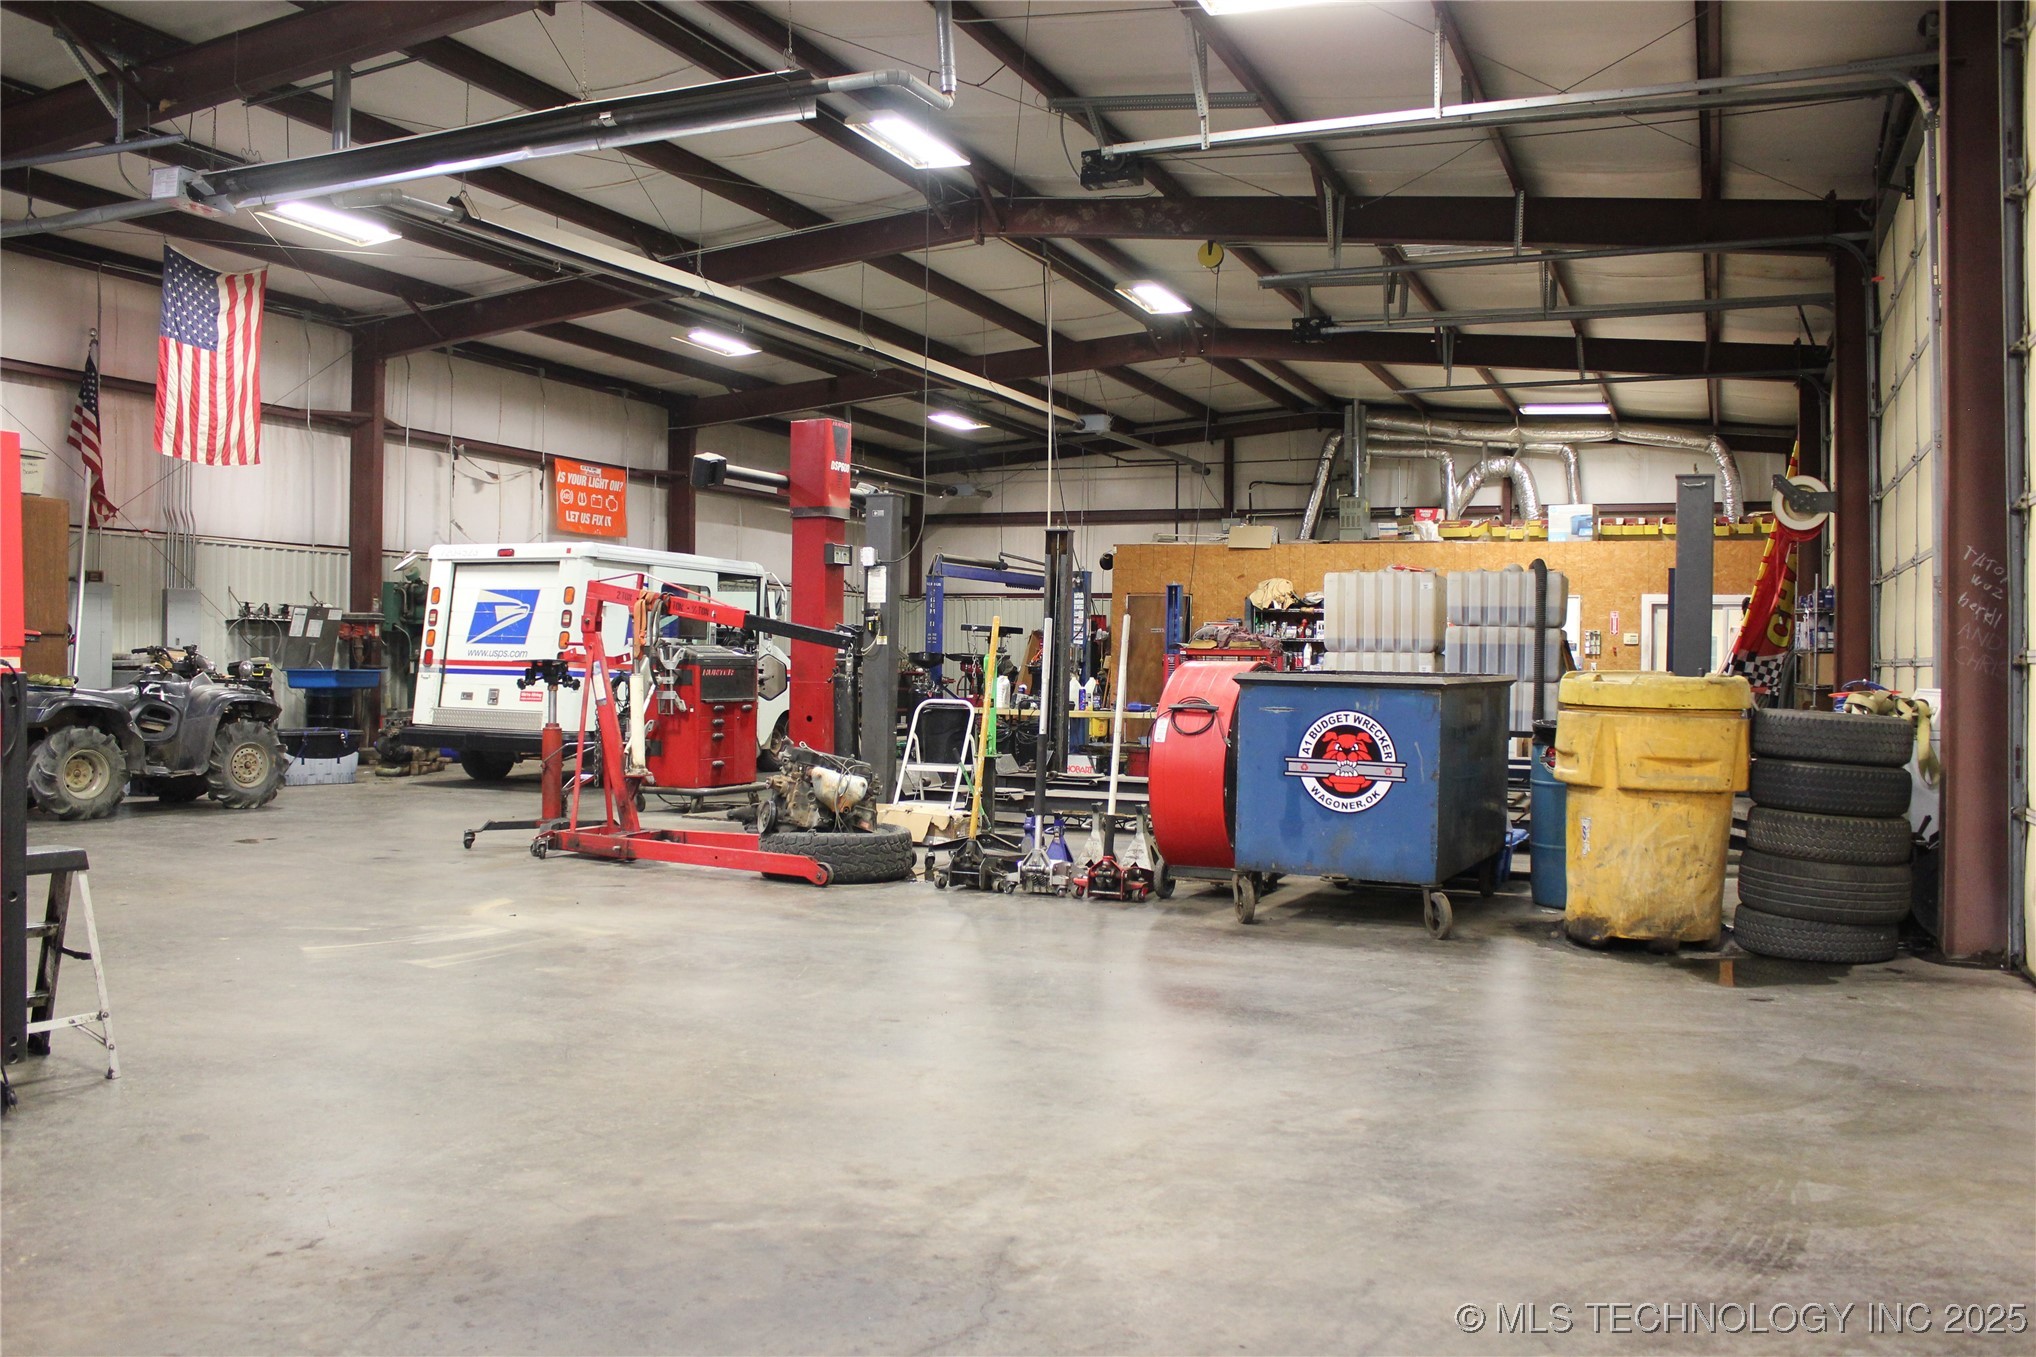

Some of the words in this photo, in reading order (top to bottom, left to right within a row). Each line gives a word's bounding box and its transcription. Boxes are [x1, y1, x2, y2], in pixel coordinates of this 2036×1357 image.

[557, 471, 566, 483] IS
[567, 473, 587, 487] YOUR
[588, 477, 609, 490] LIGHT
[609, 480, 624, 492] ON?
[566, 510, 580, 523] LET
[580, 512, 590, 524] US
[591, 514, 604, 527] FIX
[604, 516, 612, 527] IT
[467, 649, 528, 659] www.usps.com
[1302, 741, 1313, 755] A1
[1308, 713, 1350, 740] BUDGET
[1353, 714, 1393, 760] WRECKER
[1311, 786, 1367, 810] WAGONER,
[1366, 790, 1381, 804] OK
